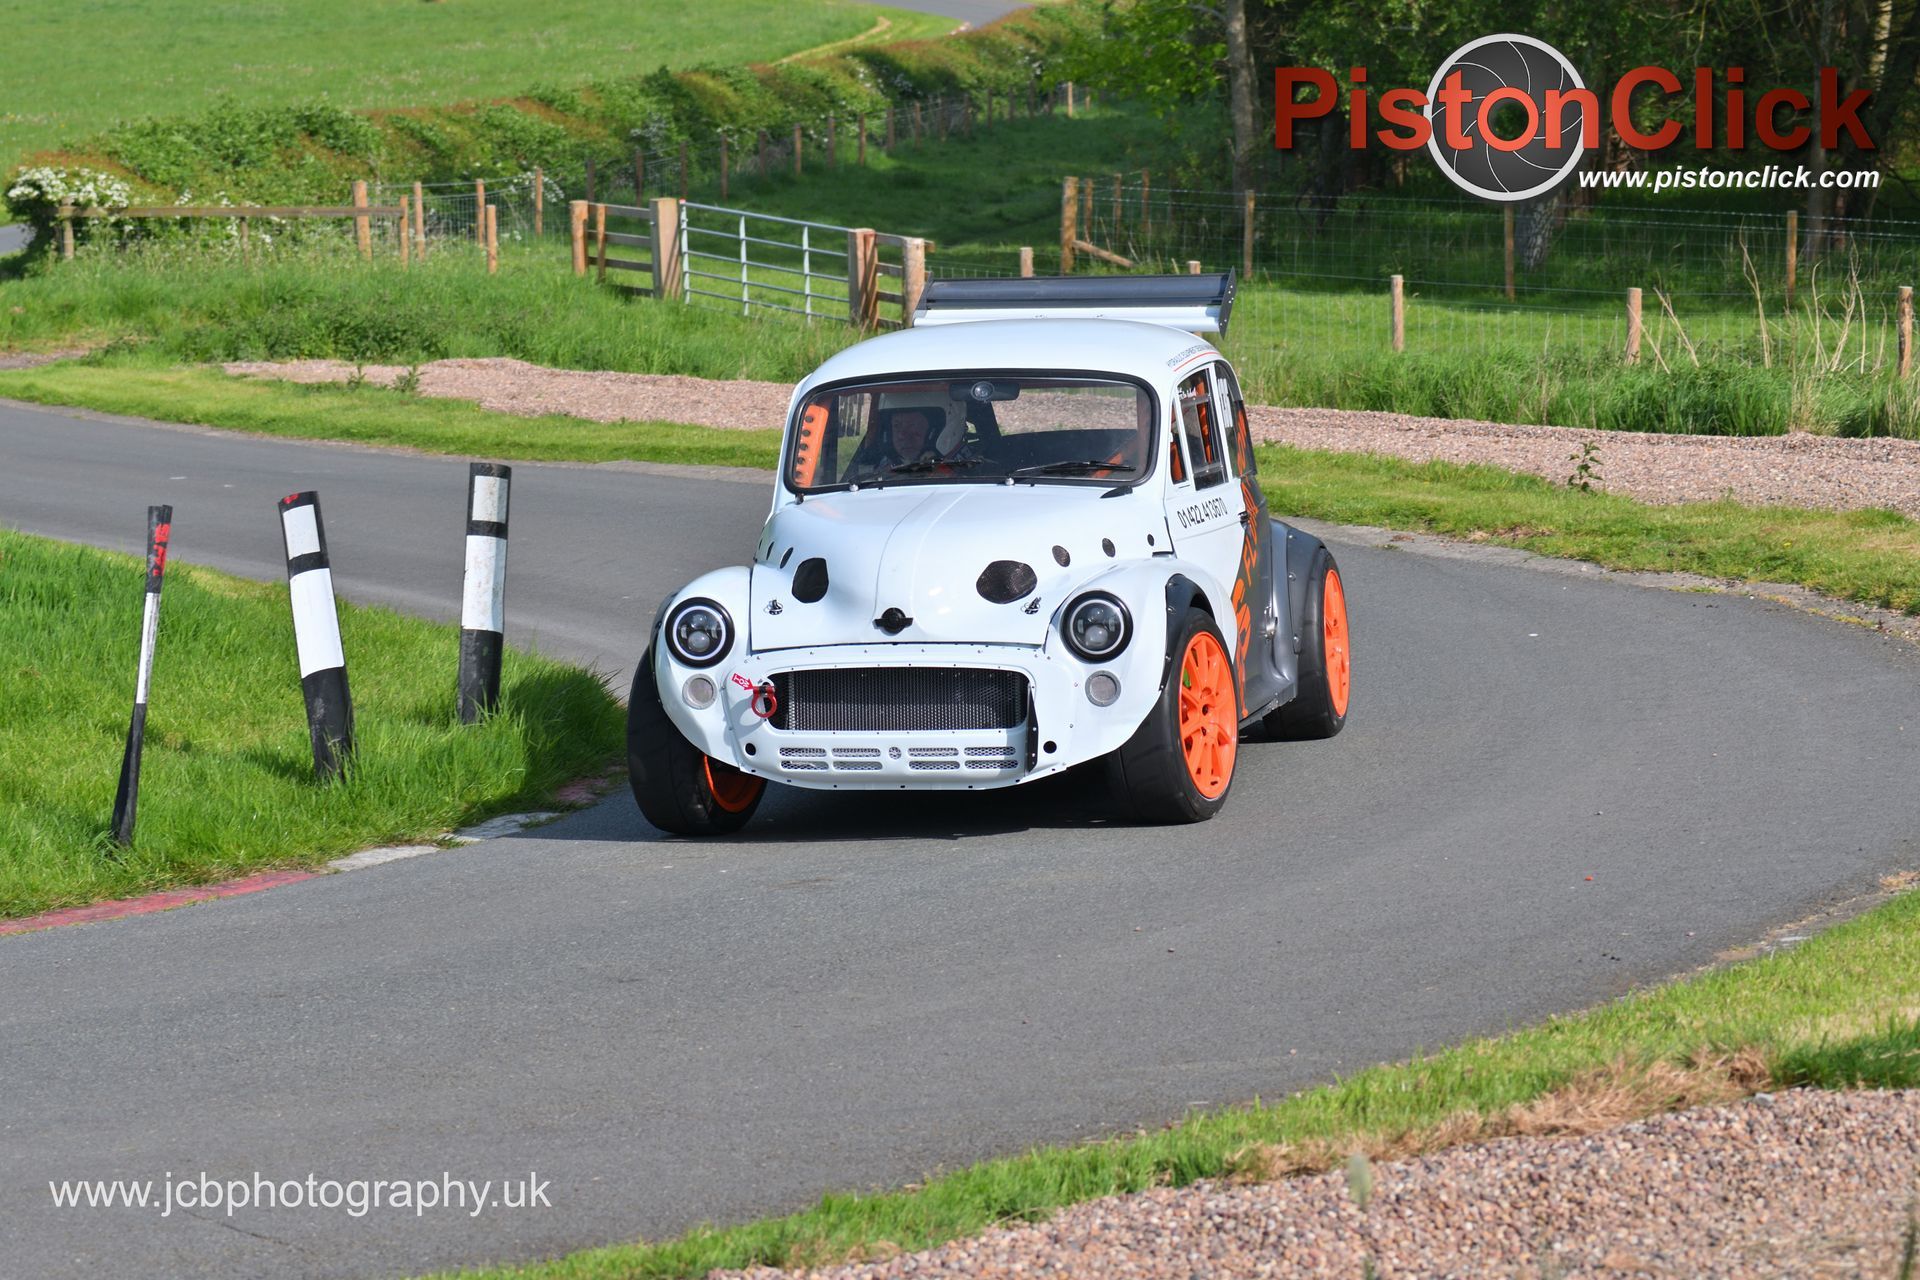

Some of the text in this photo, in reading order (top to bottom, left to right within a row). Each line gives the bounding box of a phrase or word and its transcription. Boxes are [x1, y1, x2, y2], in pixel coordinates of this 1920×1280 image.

[1177, 497, 1227, 529] 01422 413670
[733, 674, 750, 688] TOW
